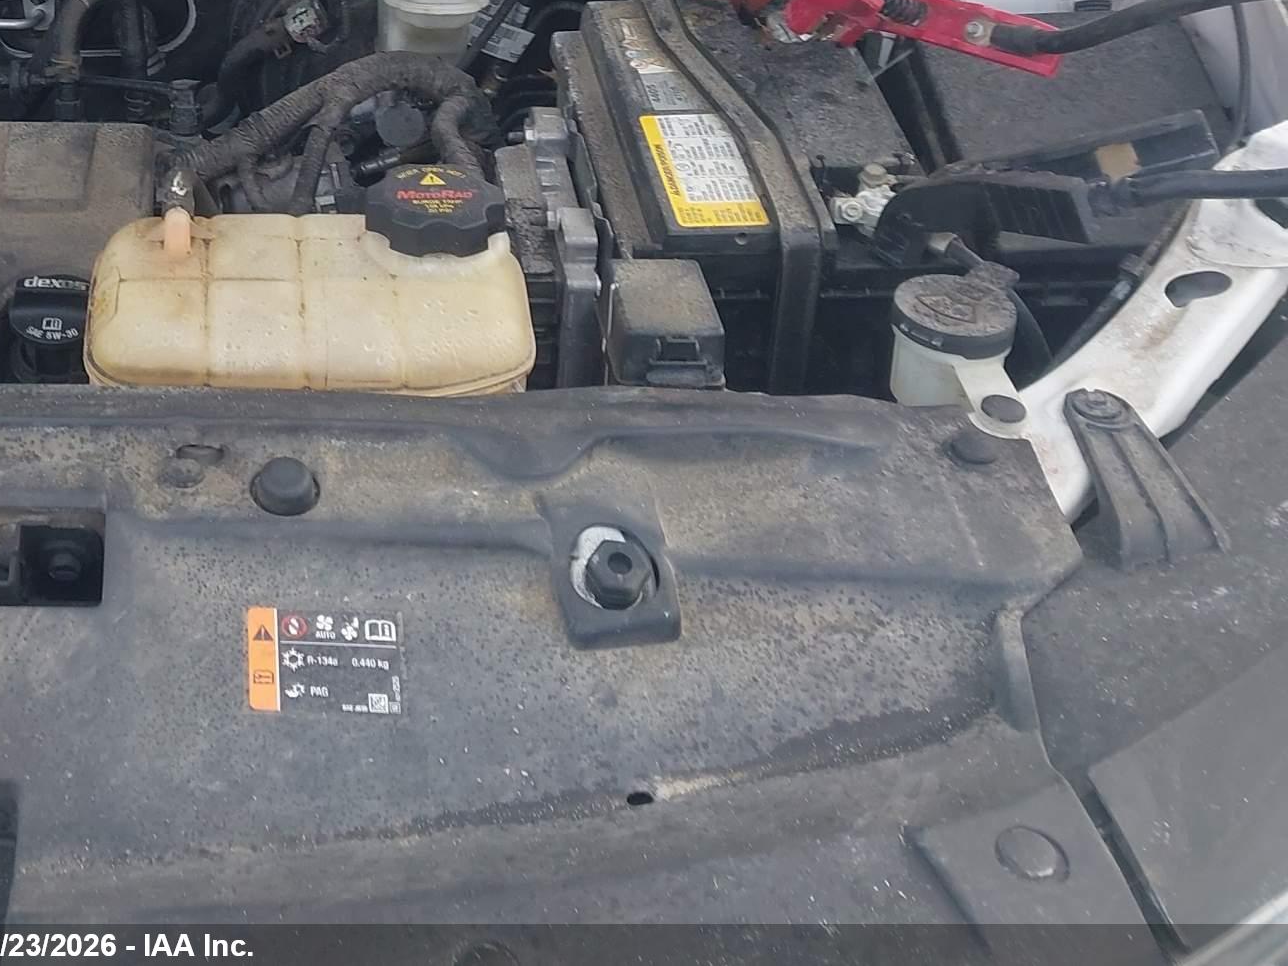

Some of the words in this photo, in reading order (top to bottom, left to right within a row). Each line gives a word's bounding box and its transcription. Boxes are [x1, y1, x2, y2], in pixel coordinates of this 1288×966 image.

[26, 326, 43, 339] SAE
[45, 328, 79, 340] 5W-30
[315, 630, 336, 640] AUTO
[307, 655, 339, 667] R-134a
[351, 657, 376, 668] 0.440
[377, 659, 390, 671] kg
[310, 686, 329, 697] PAG
